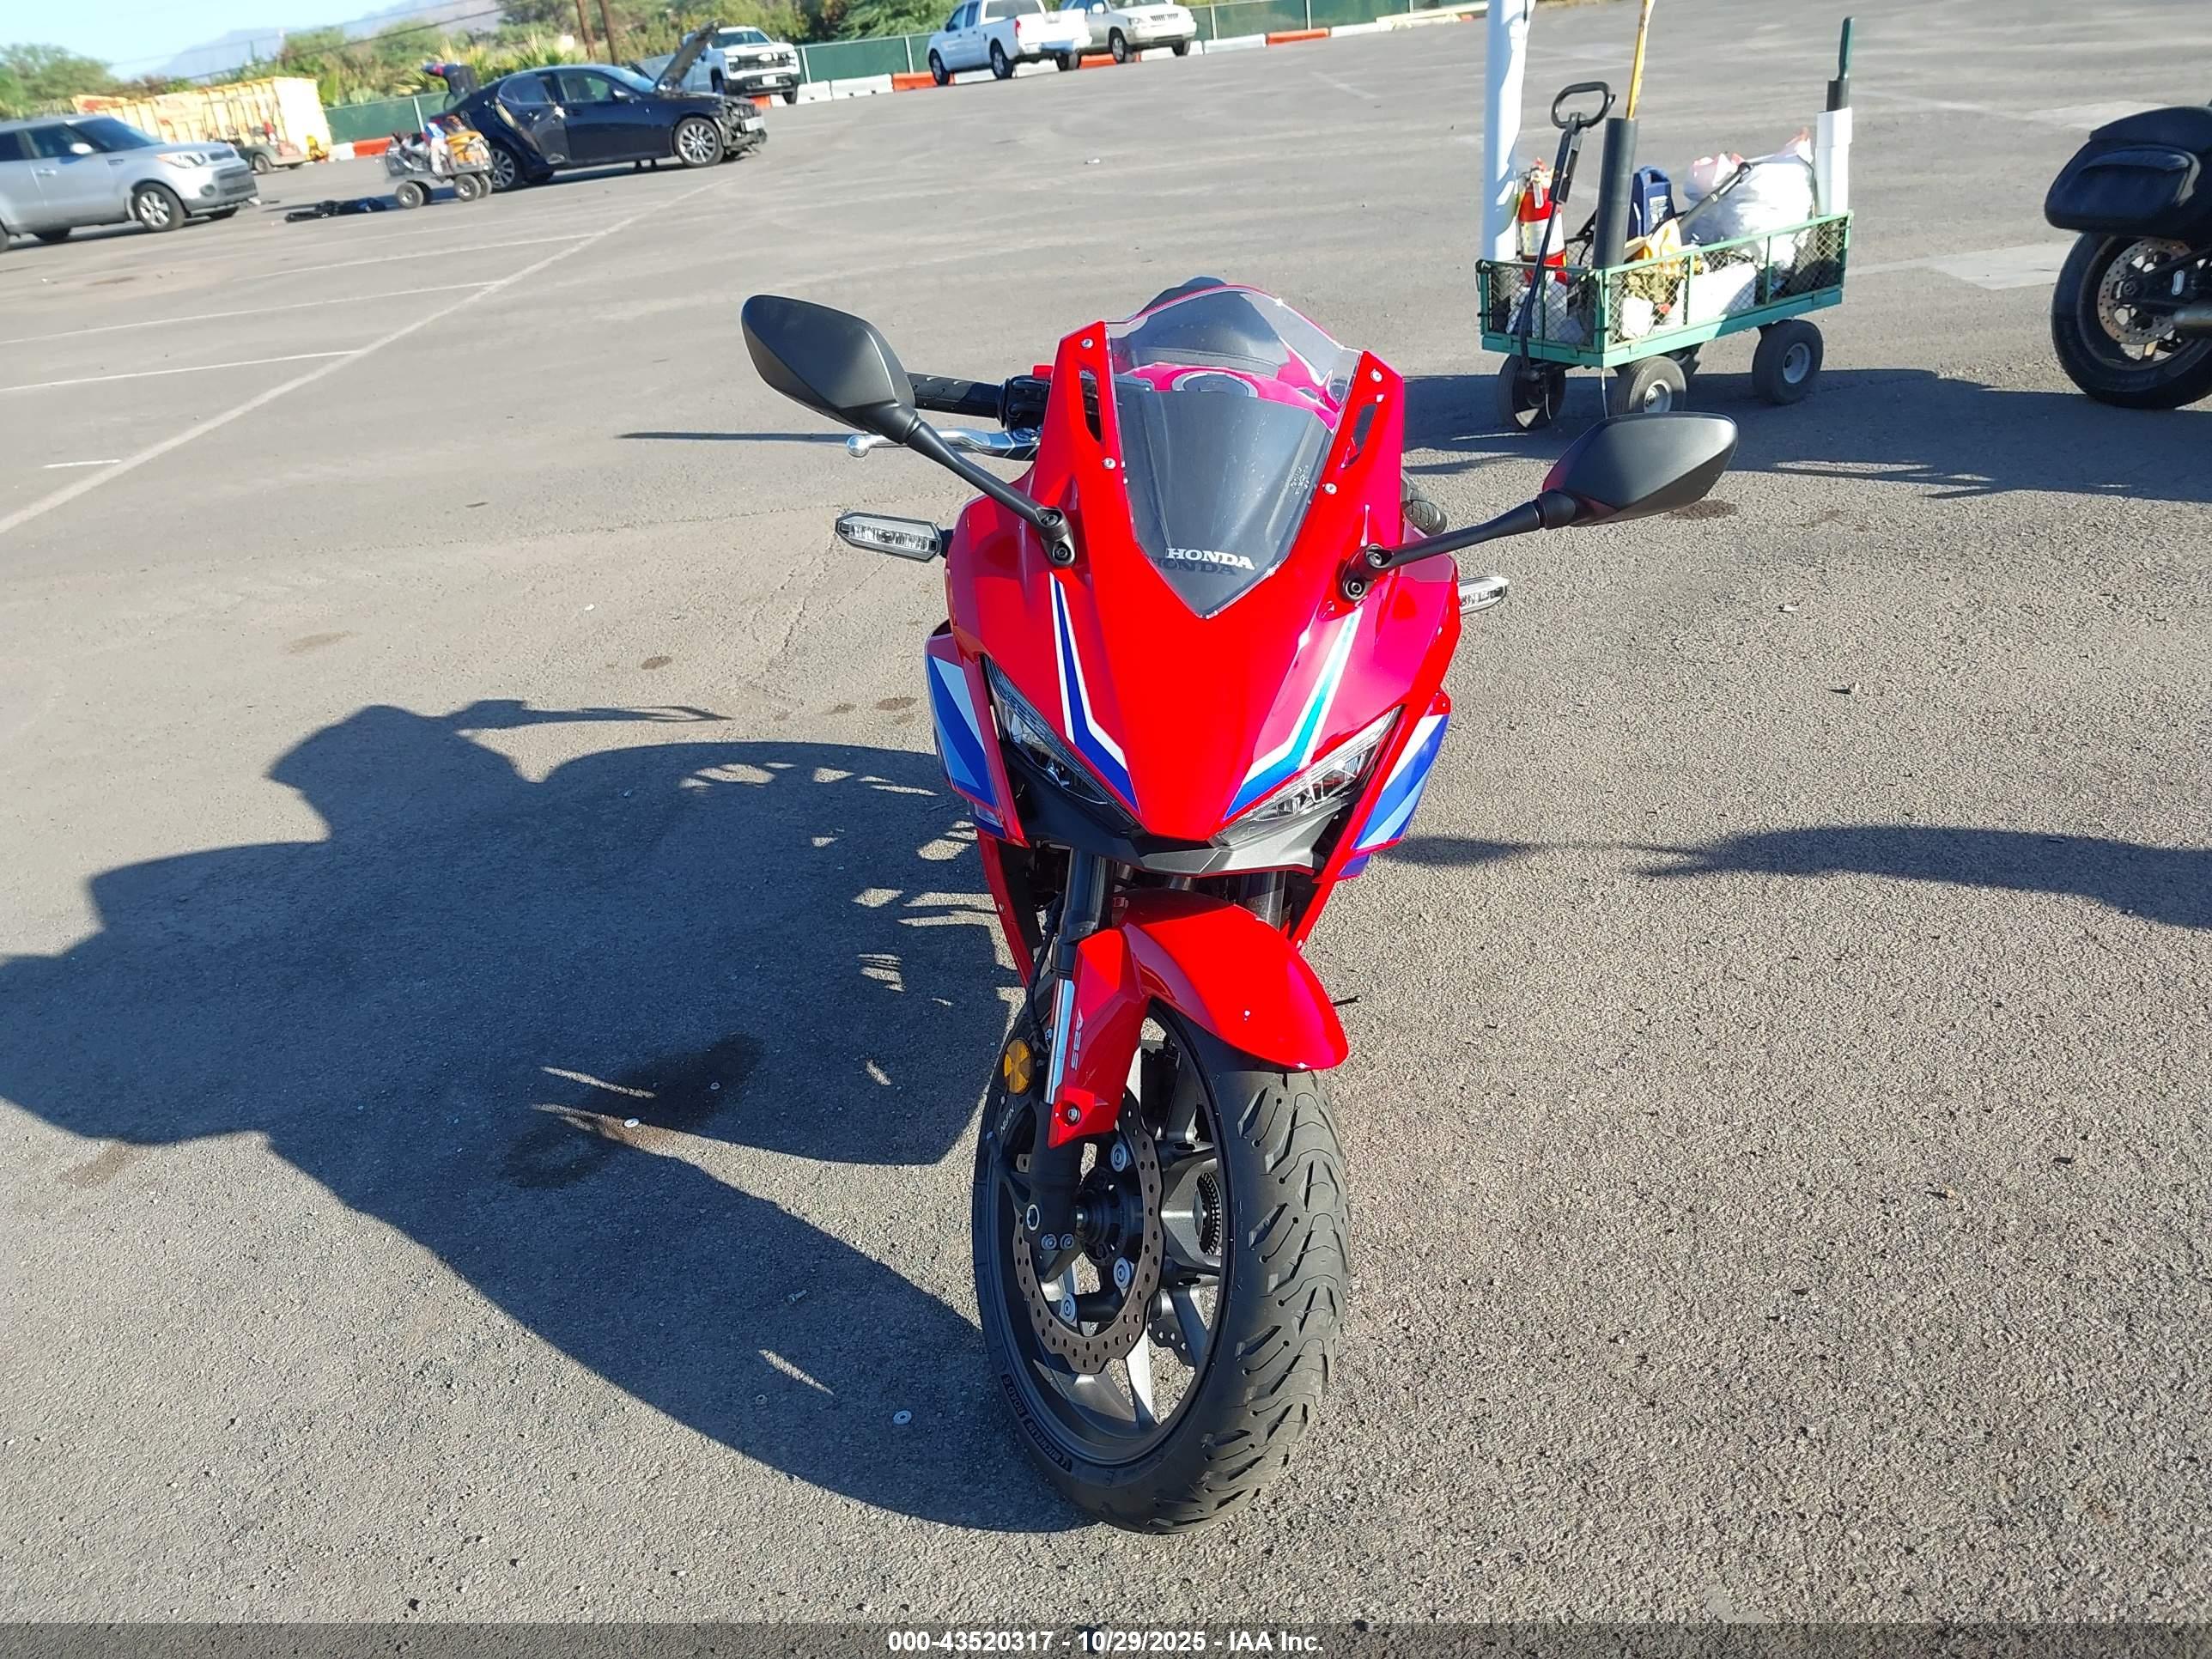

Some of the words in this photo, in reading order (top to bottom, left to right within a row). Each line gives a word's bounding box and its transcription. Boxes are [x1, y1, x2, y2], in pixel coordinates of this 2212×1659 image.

[1167, 548, 1255, 570] HONDA
[1071, 1007, 1084, 1071] ABS
[1007, 1386, 1025, 1416] ROAD
[1026, 1421, 1061, 1461] MICHELIN
